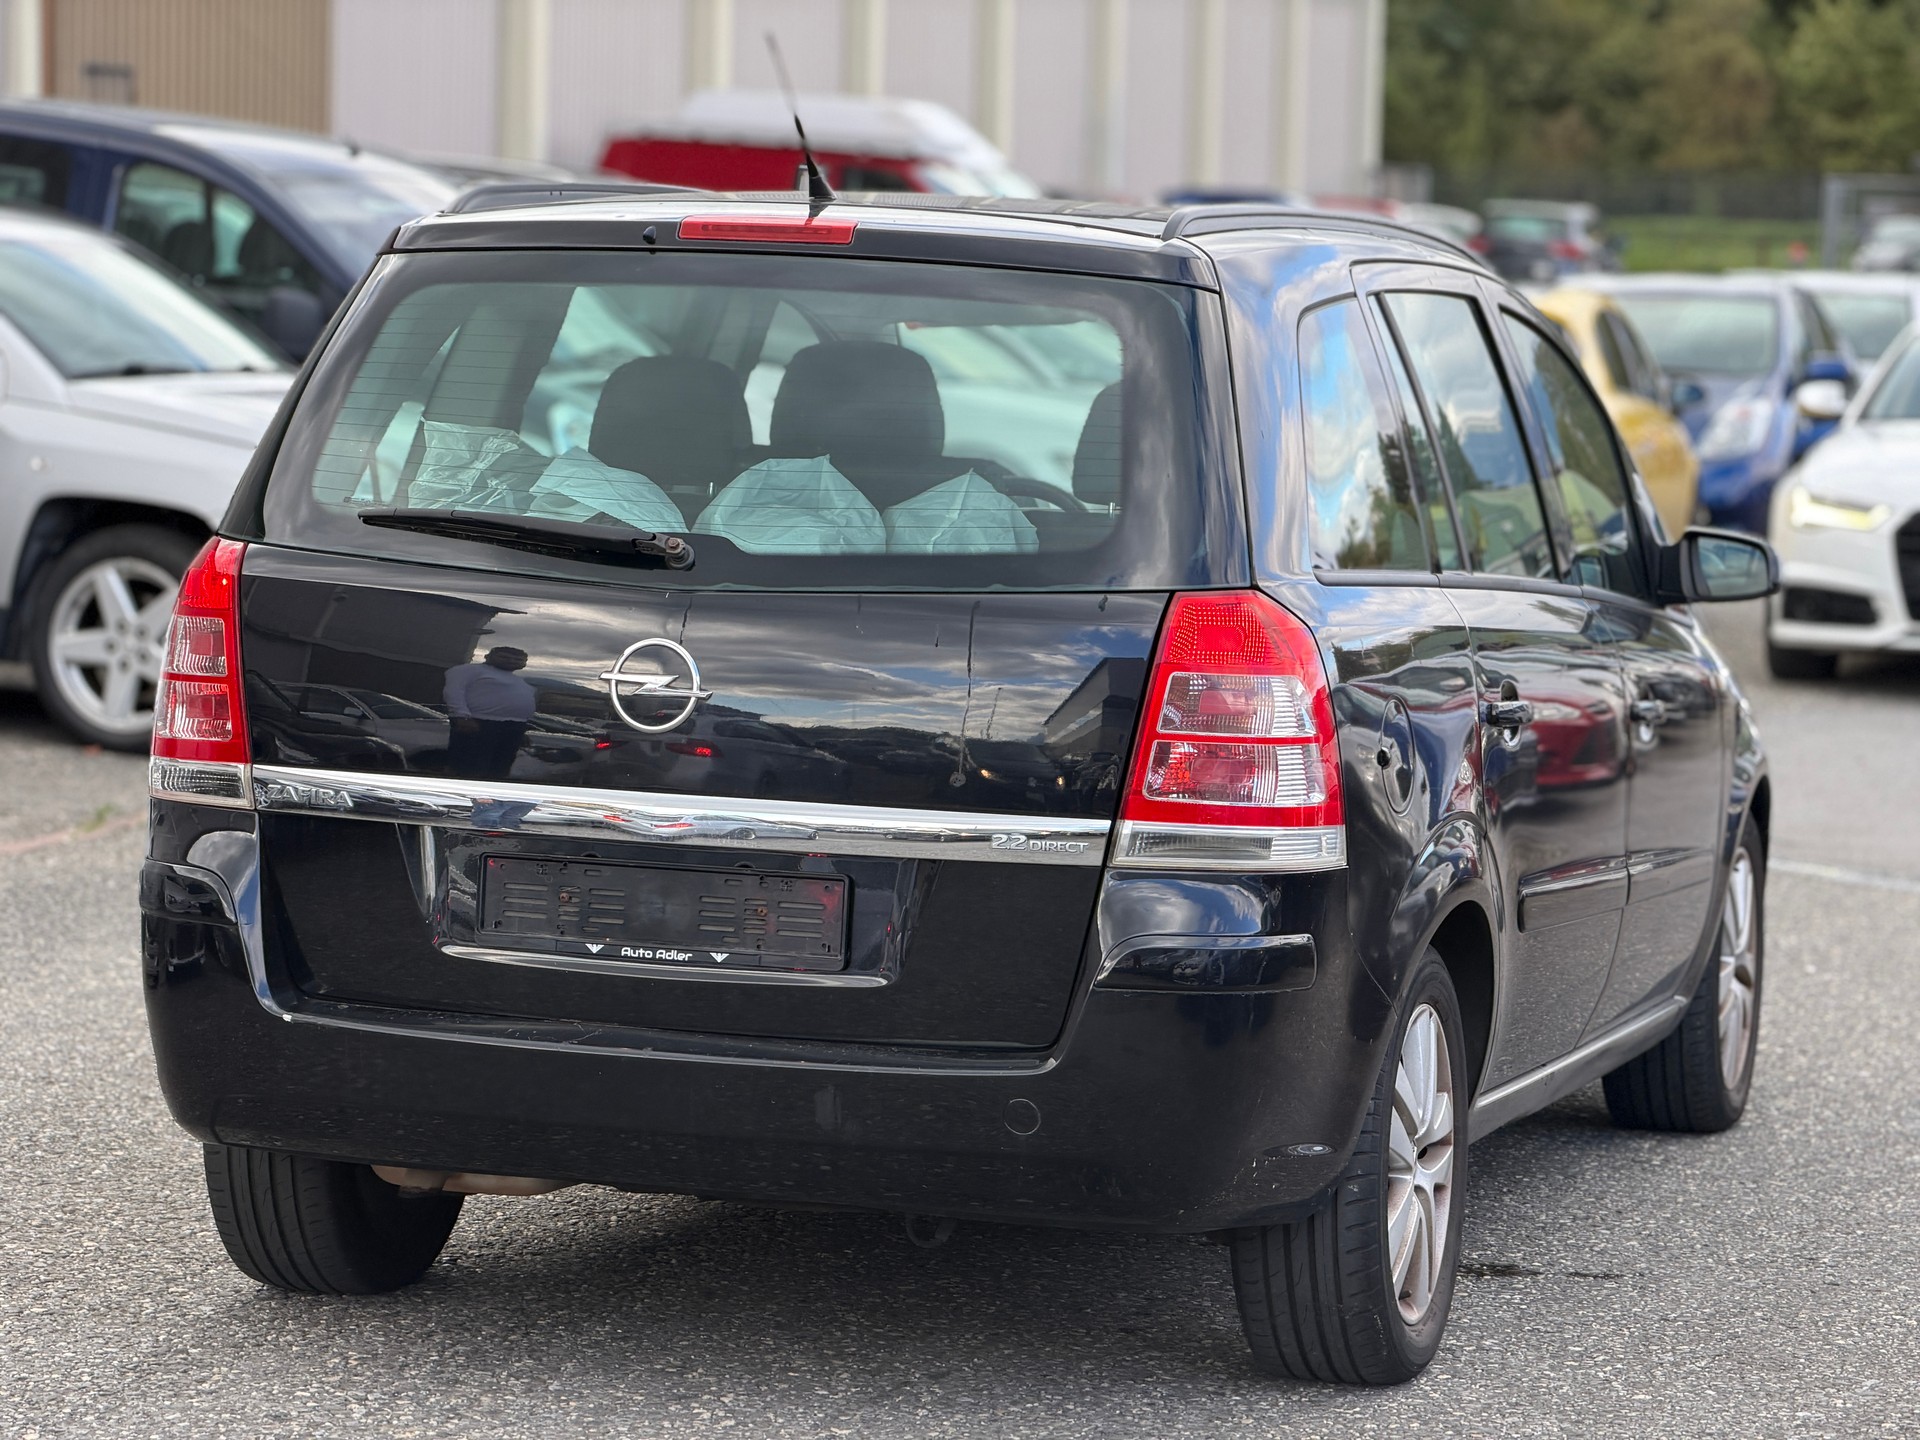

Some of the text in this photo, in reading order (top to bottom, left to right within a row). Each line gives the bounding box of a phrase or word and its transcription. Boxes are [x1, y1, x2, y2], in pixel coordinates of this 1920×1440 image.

[267, 784, 354, 807] ZAFIRA
[1029, 840, 1089, 853] DIRECT
[621, 947, 693, 961] Auto Adler
